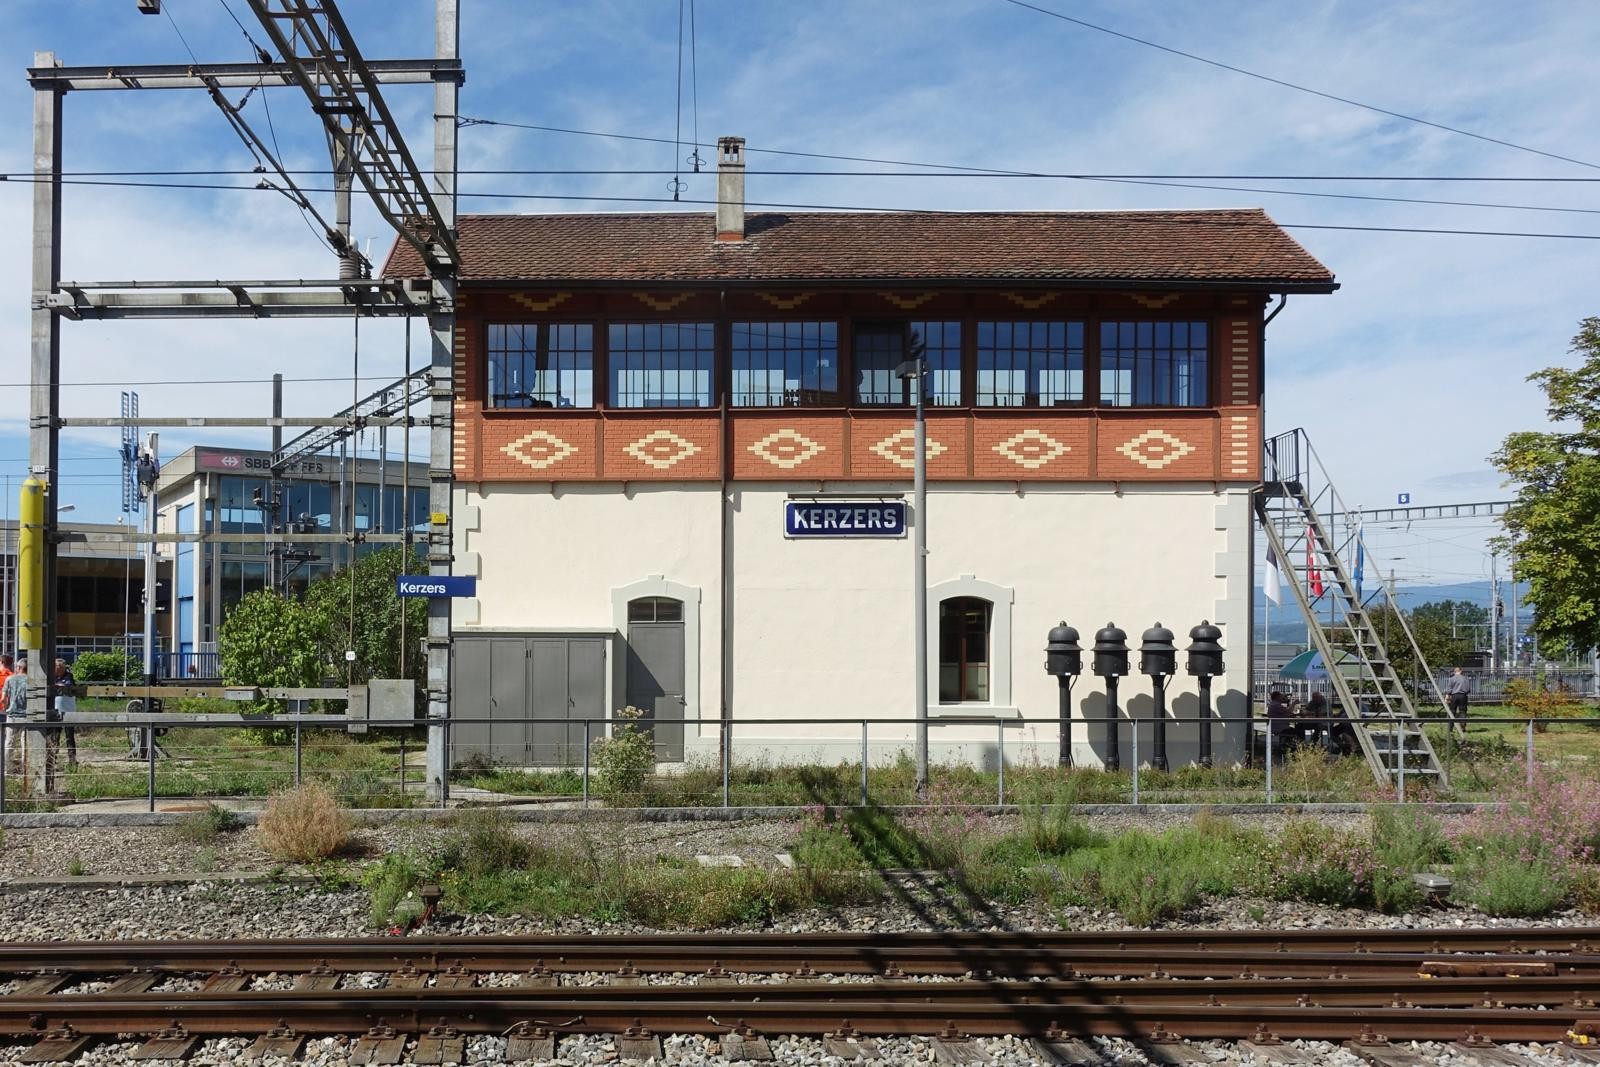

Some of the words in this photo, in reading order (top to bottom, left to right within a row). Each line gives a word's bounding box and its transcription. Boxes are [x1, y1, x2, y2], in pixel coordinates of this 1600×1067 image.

[244, 457, 271, 469] SBB
[794, 508, 897, 529] KERZERS
[400, 582, 447, 594] Kerzers
